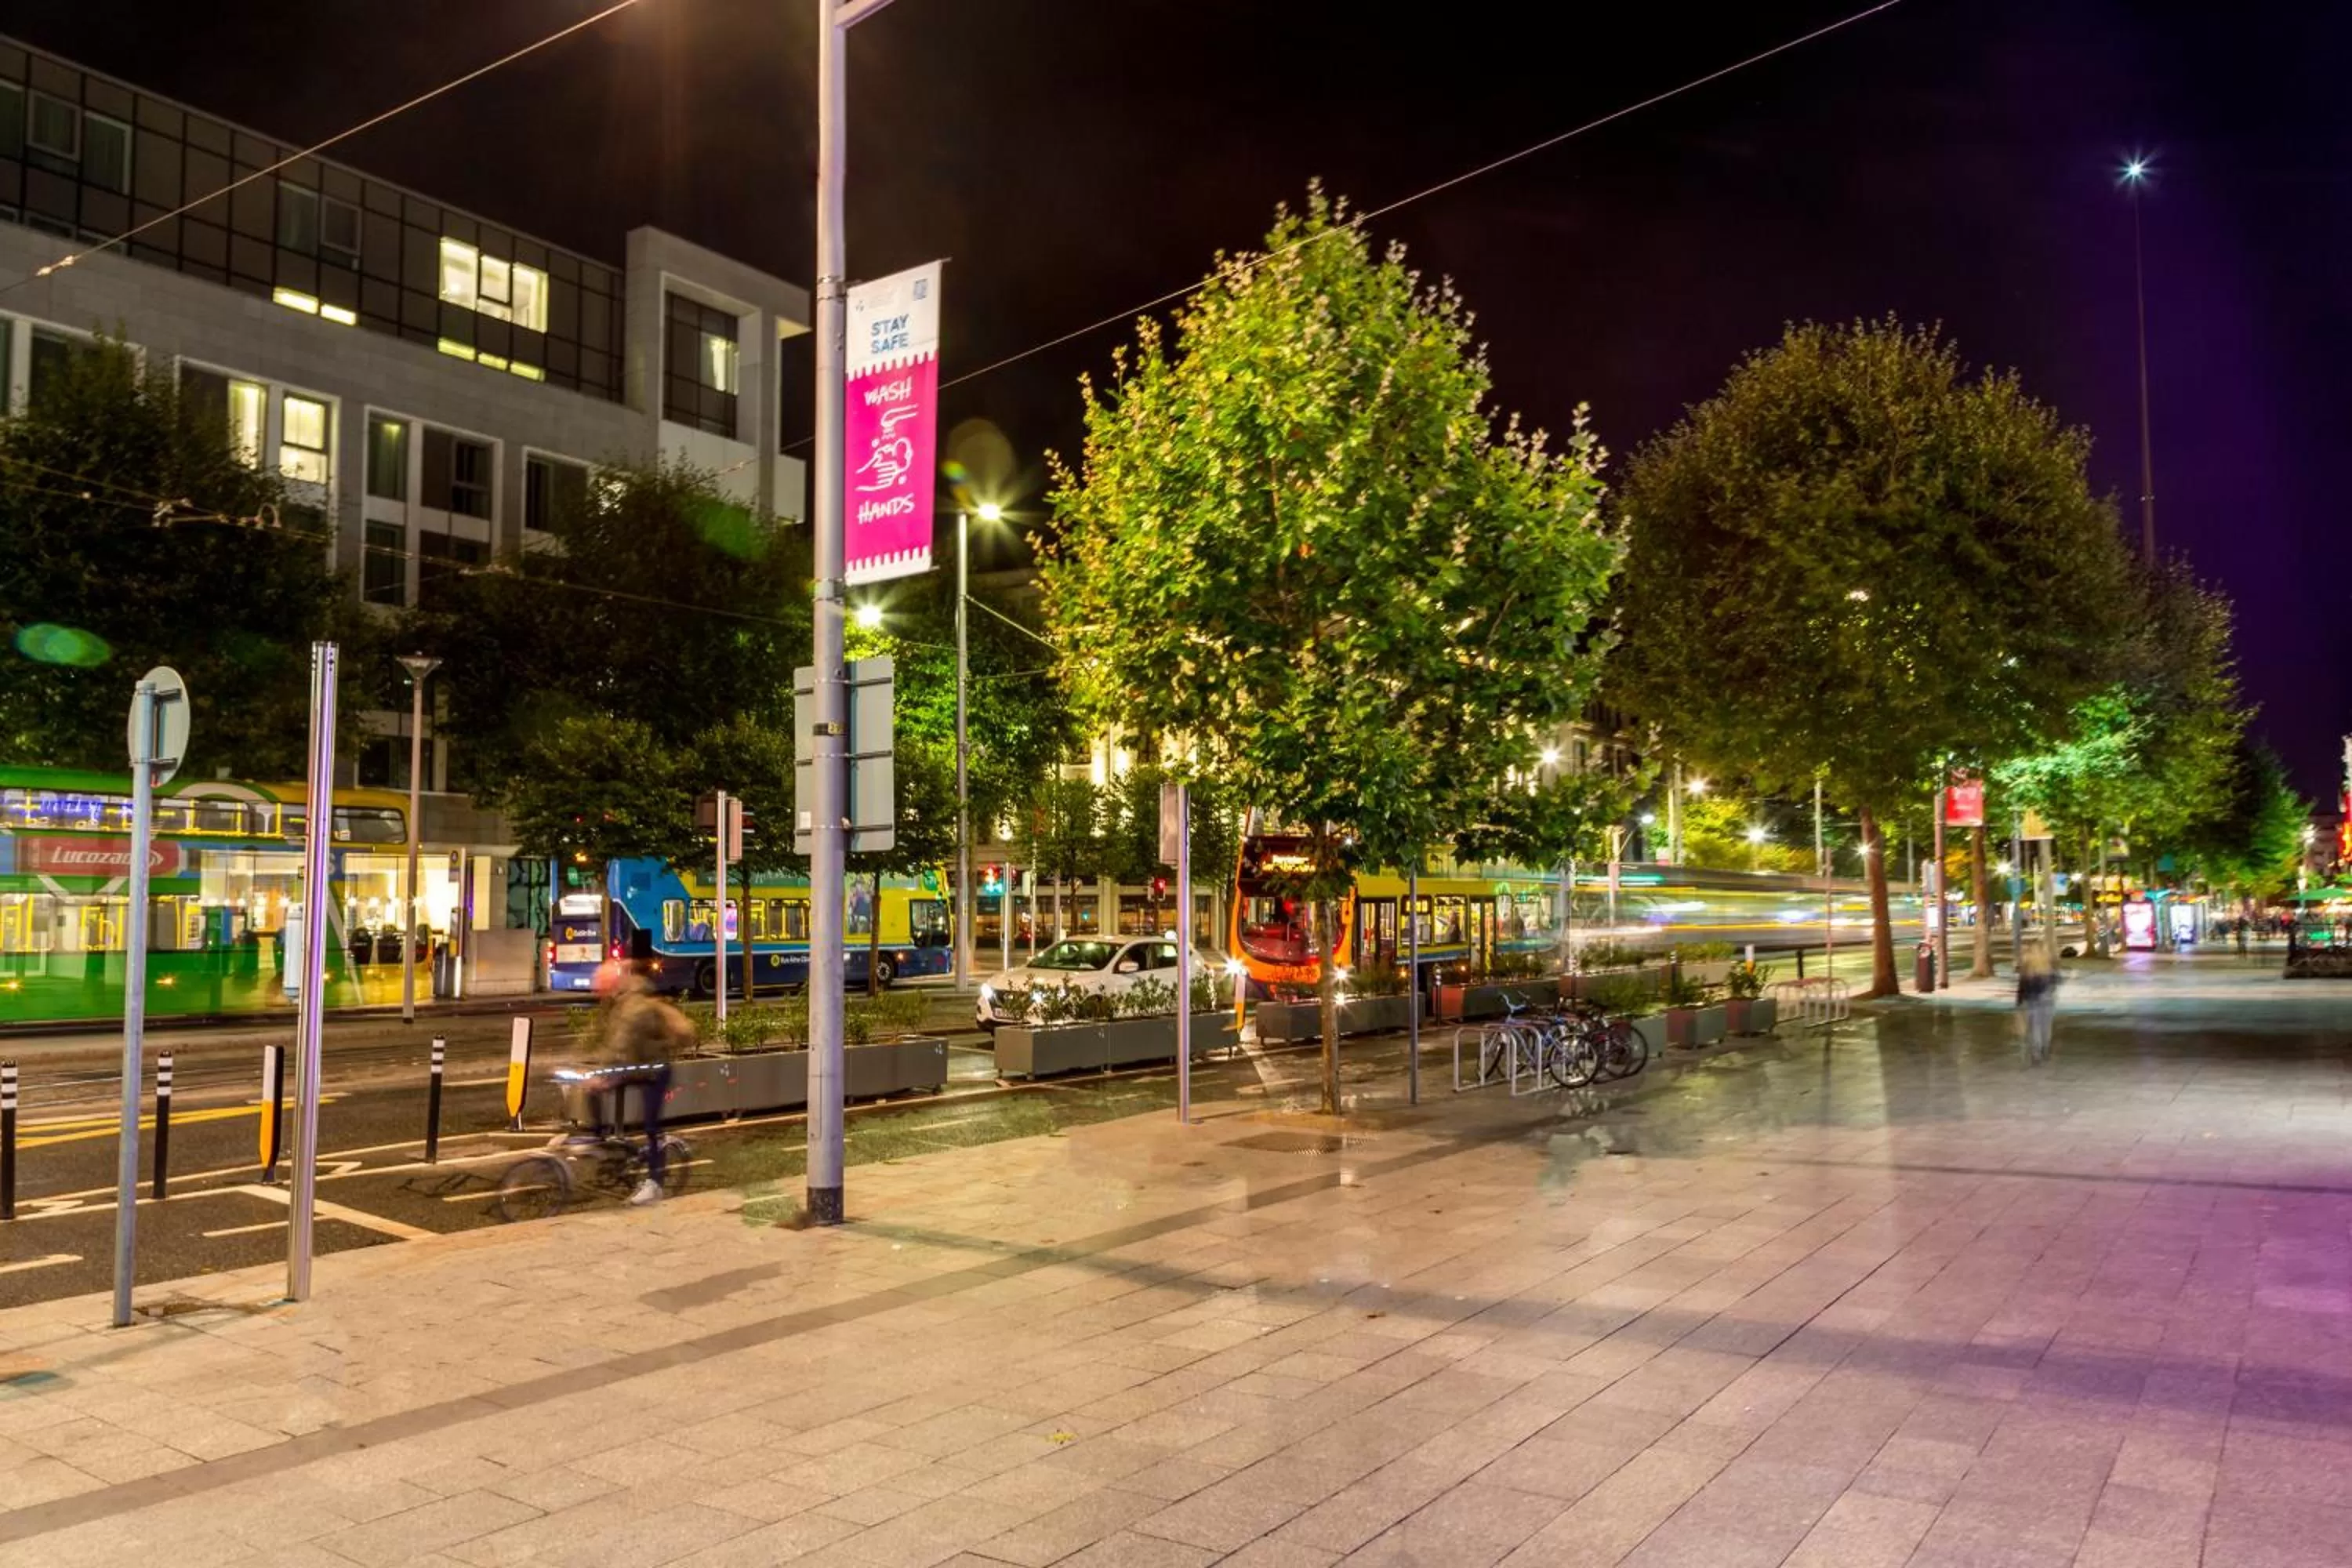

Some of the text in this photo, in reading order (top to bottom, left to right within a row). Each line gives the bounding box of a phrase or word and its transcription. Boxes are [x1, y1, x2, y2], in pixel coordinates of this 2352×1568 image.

[871, 314, 909, 336] STAY
[871, 332, 909, 354] SAFE
[864, 376, 913, 406] WASH
[858, 492, 915, 524] HANDS
[50, 845, 157, 866] Lucozad
